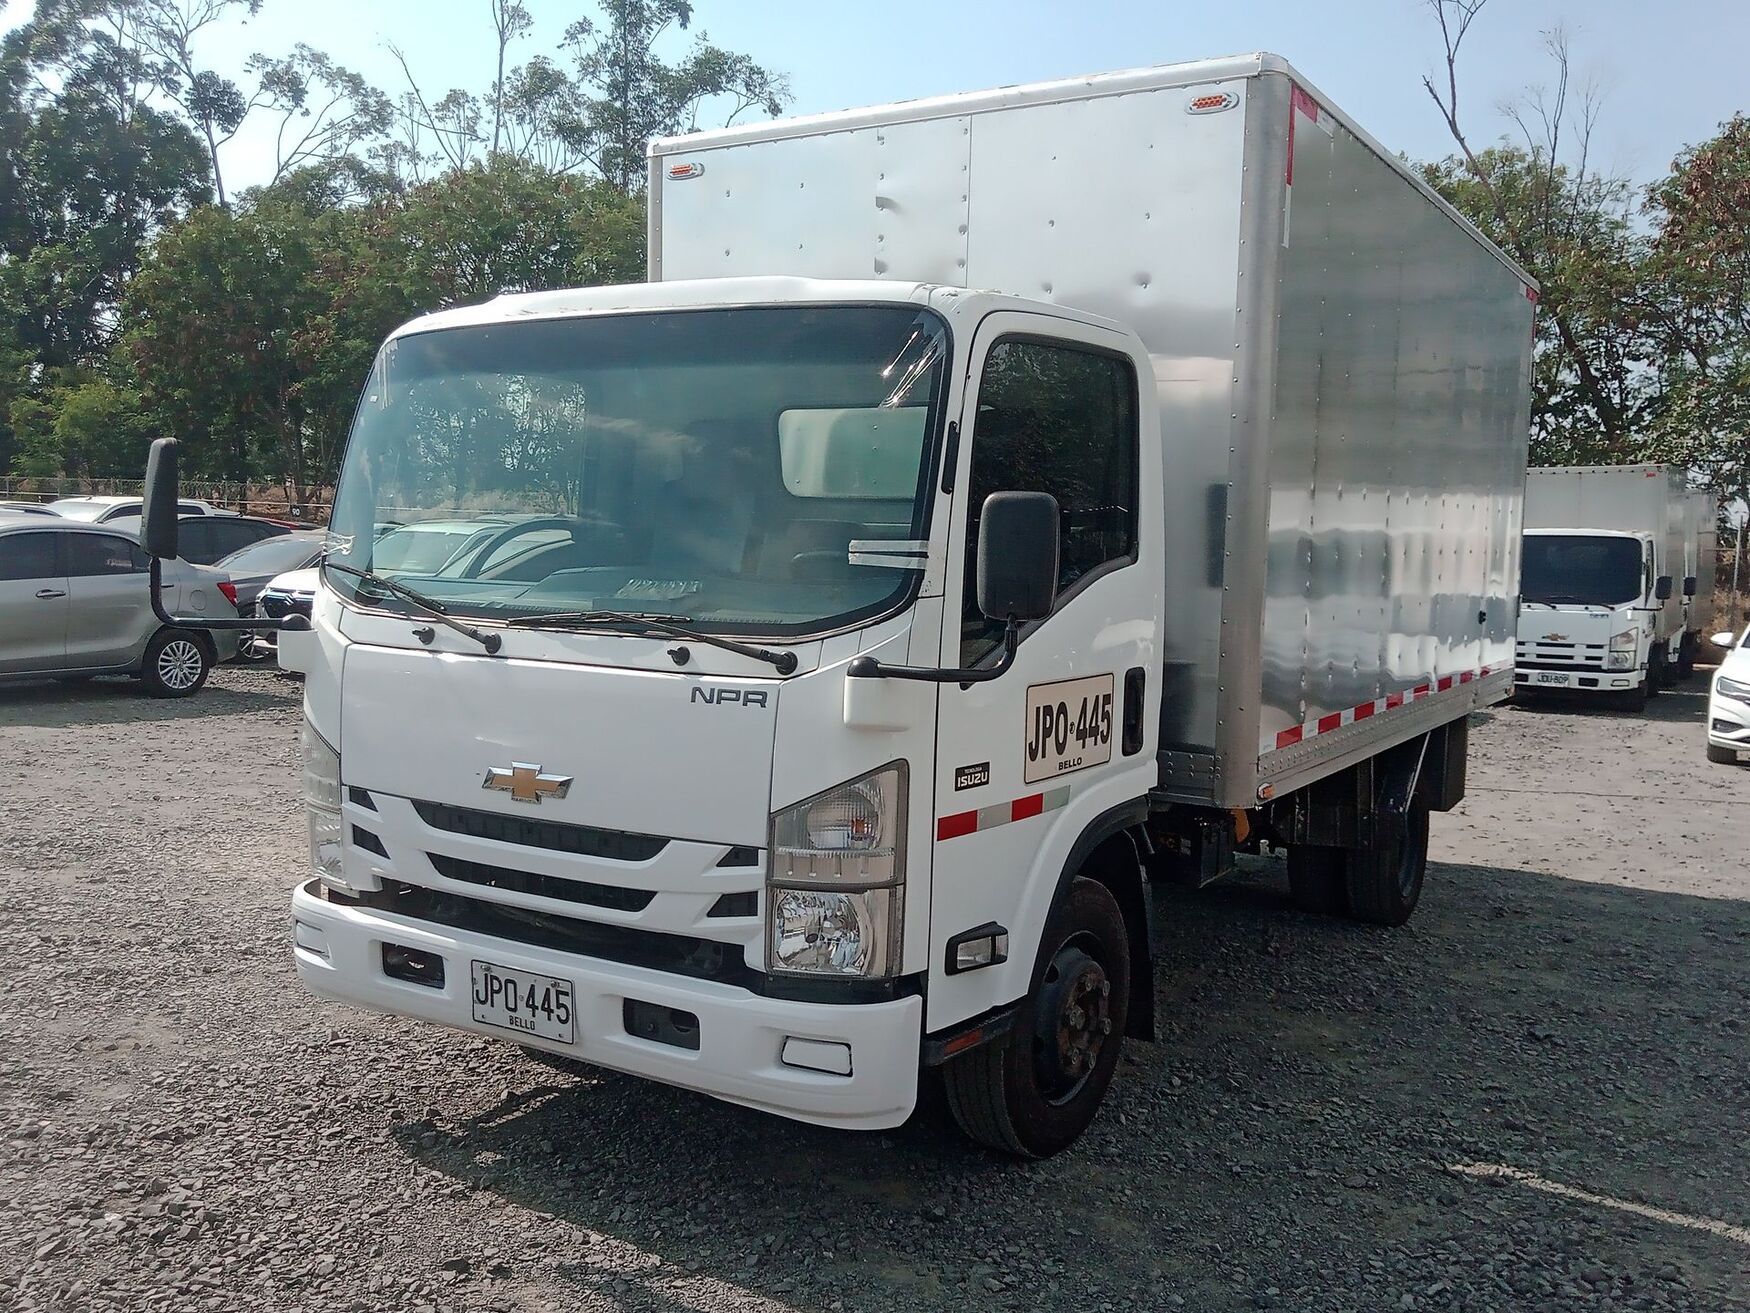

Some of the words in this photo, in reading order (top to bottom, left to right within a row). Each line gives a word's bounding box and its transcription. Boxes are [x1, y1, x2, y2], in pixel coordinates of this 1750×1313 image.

[690, 686, 768, 708] NPR
[1058, 757, 1083, 771] BELLO
[957, 771, 989, 788] ISUZU
[509, 1015, 536, 1031] BELLO
